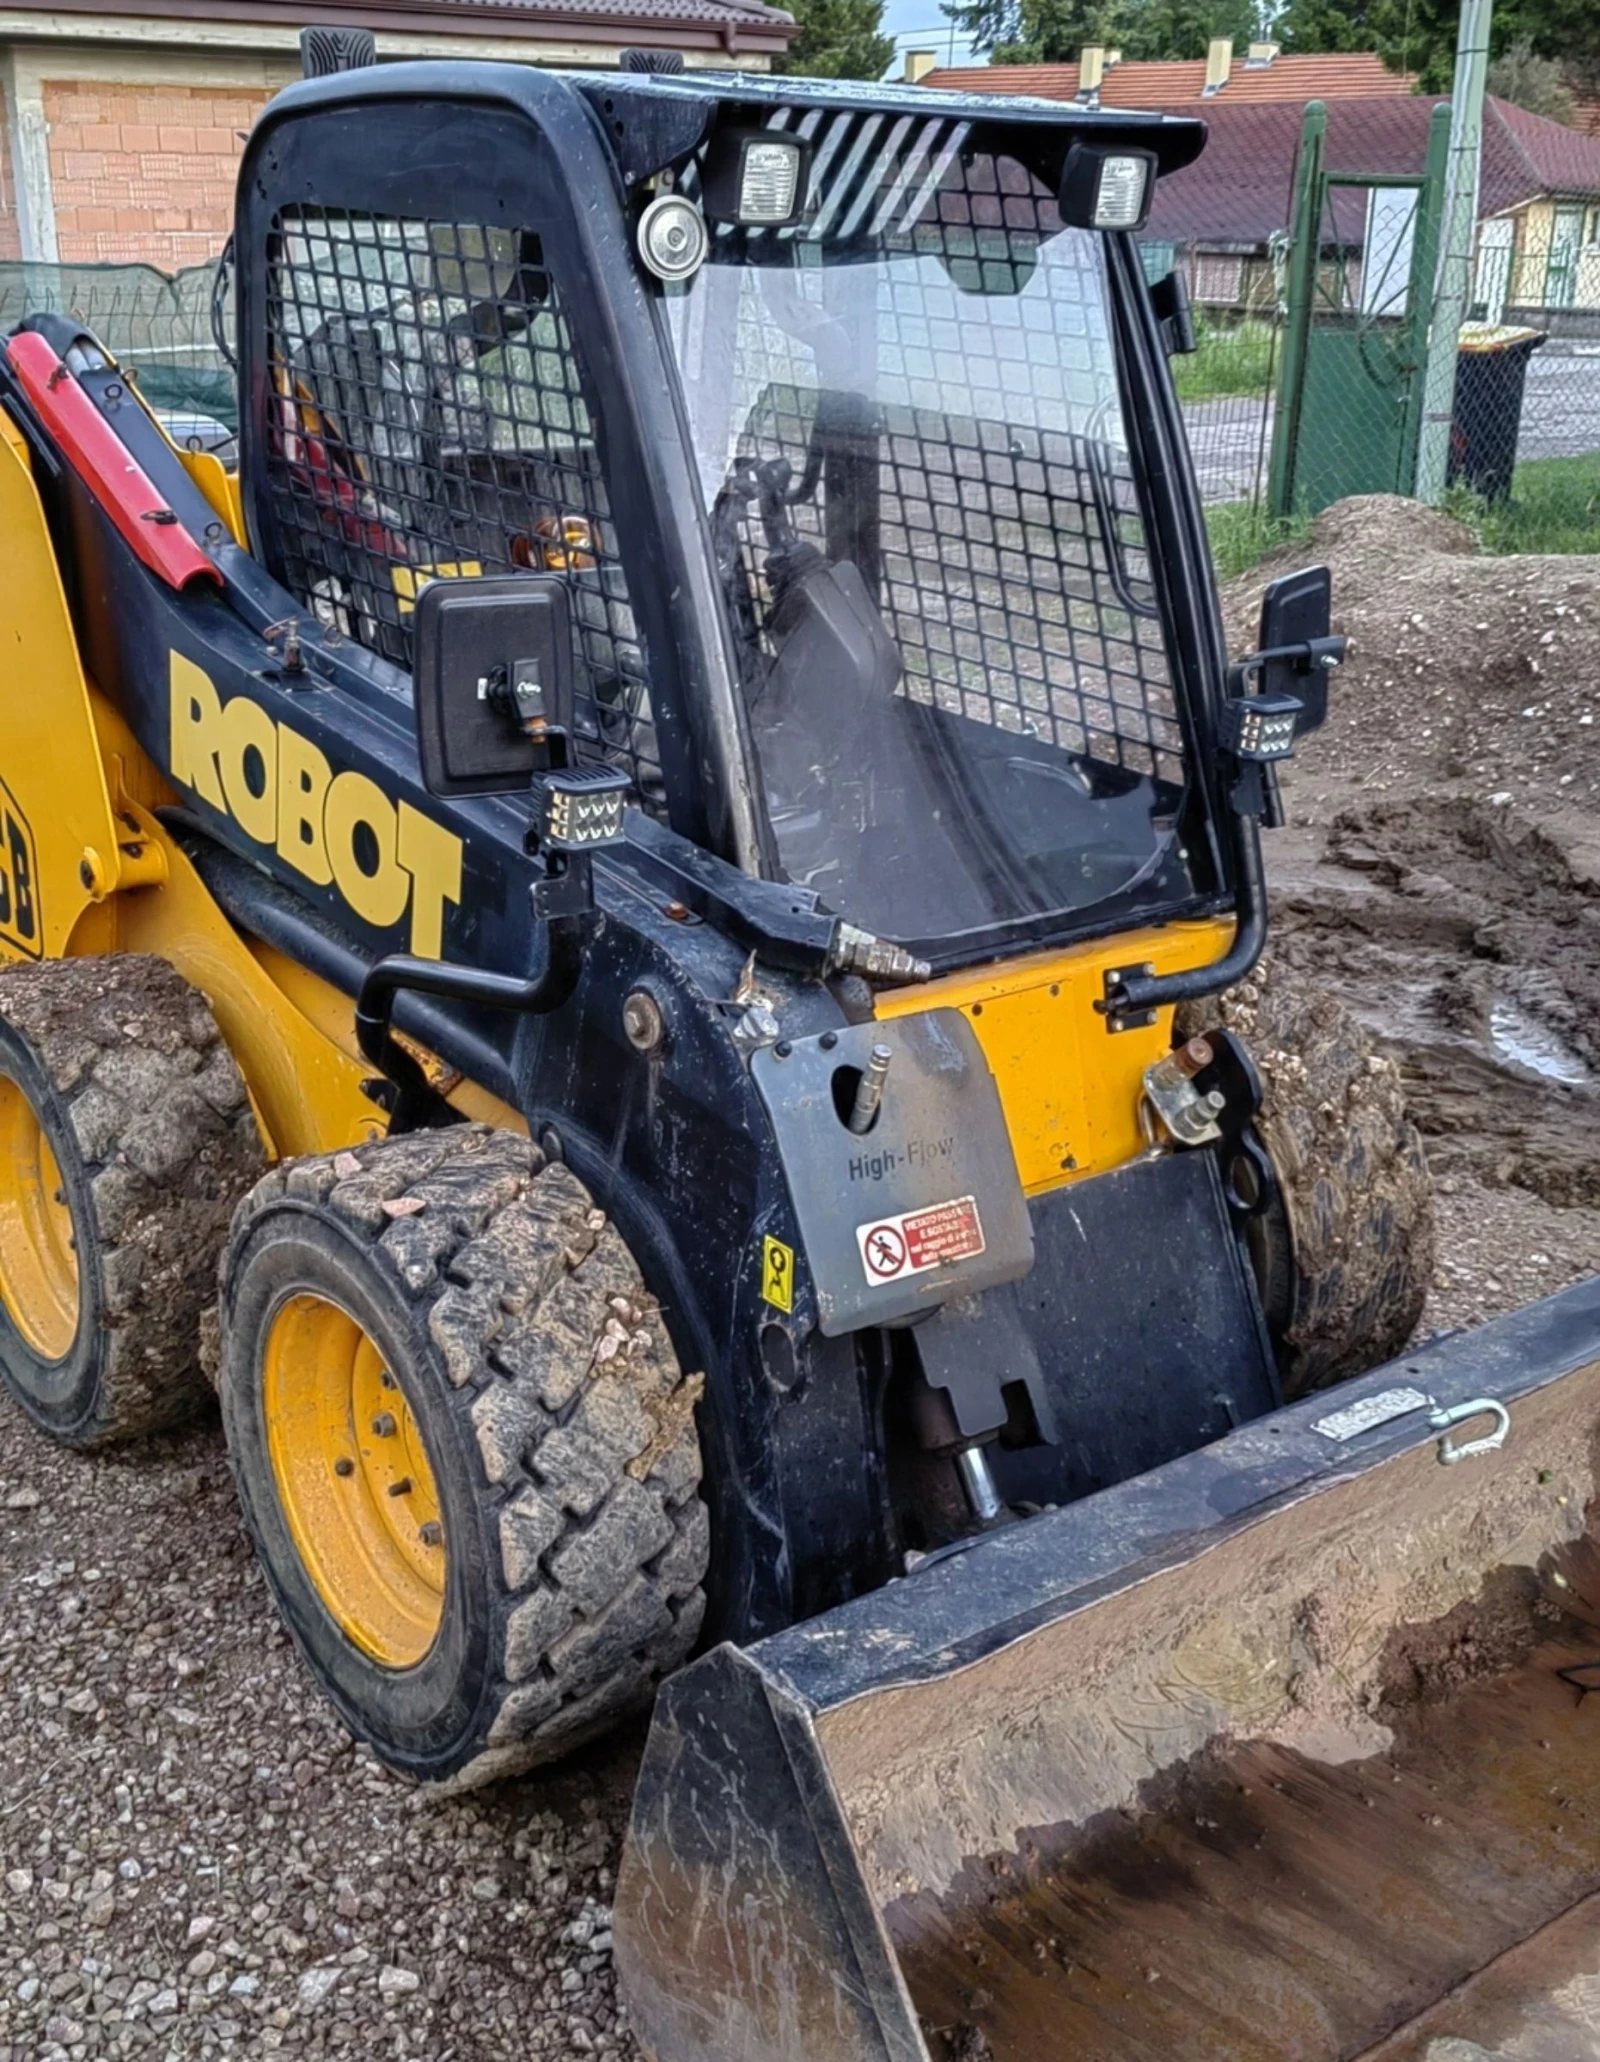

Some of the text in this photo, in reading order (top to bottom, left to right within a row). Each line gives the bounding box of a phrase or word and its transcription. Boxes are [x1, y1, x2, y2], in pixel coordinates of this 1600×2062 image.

[170, 648, 462, 960] ROBOT
[0, 806, 35, 940] B
[849, 1138, 953, 1181] High-Flow
